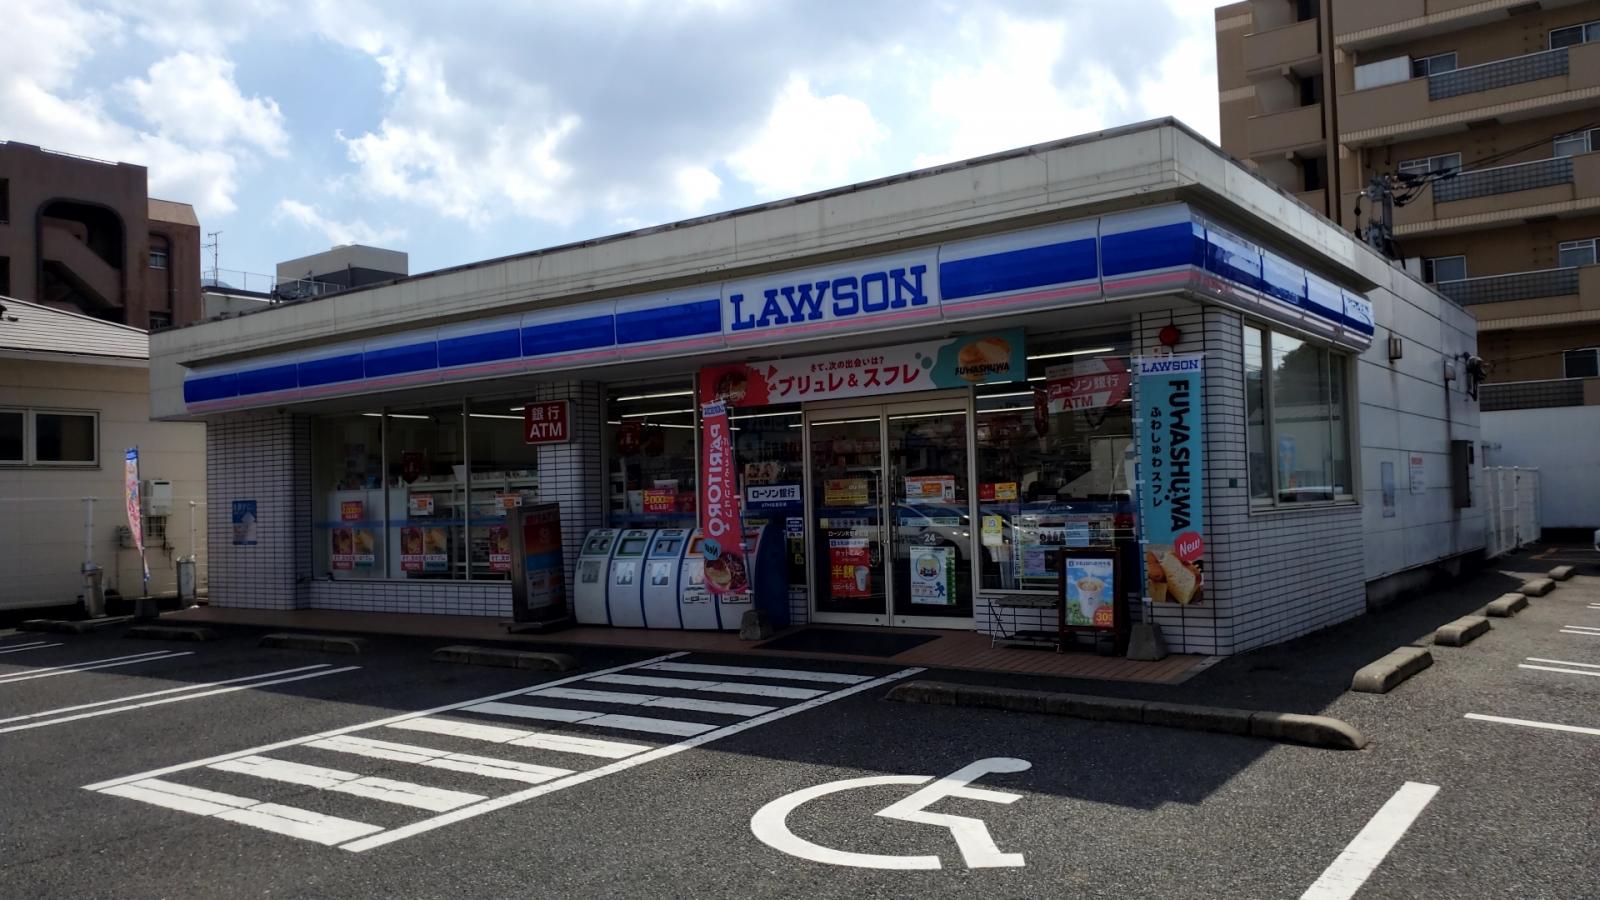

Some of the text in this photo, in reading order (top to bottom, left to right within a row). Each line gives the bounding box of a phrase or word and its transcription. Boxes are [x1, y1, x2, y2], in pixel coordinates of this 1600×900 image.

[730, 264, 928, 331] LAWSON
[954, 362, 1010, 376] FUWASHUWA
[1141, 359, 1199, 373] LAWSON
[1062, 395, 1094, 410] ATM
[531, 405, 560, 422] 銀行
[529, 422, 562, 439] ATM
[1150, 406, 1163, 507] ふわしゅわスフレ
[1168, 379, 1191, 532] FUWASHUWA
[752, 487, 797, 499] ローソン銀行
[923, 533, 936, 543] 24
[1179, 538, 1200, 557] New
